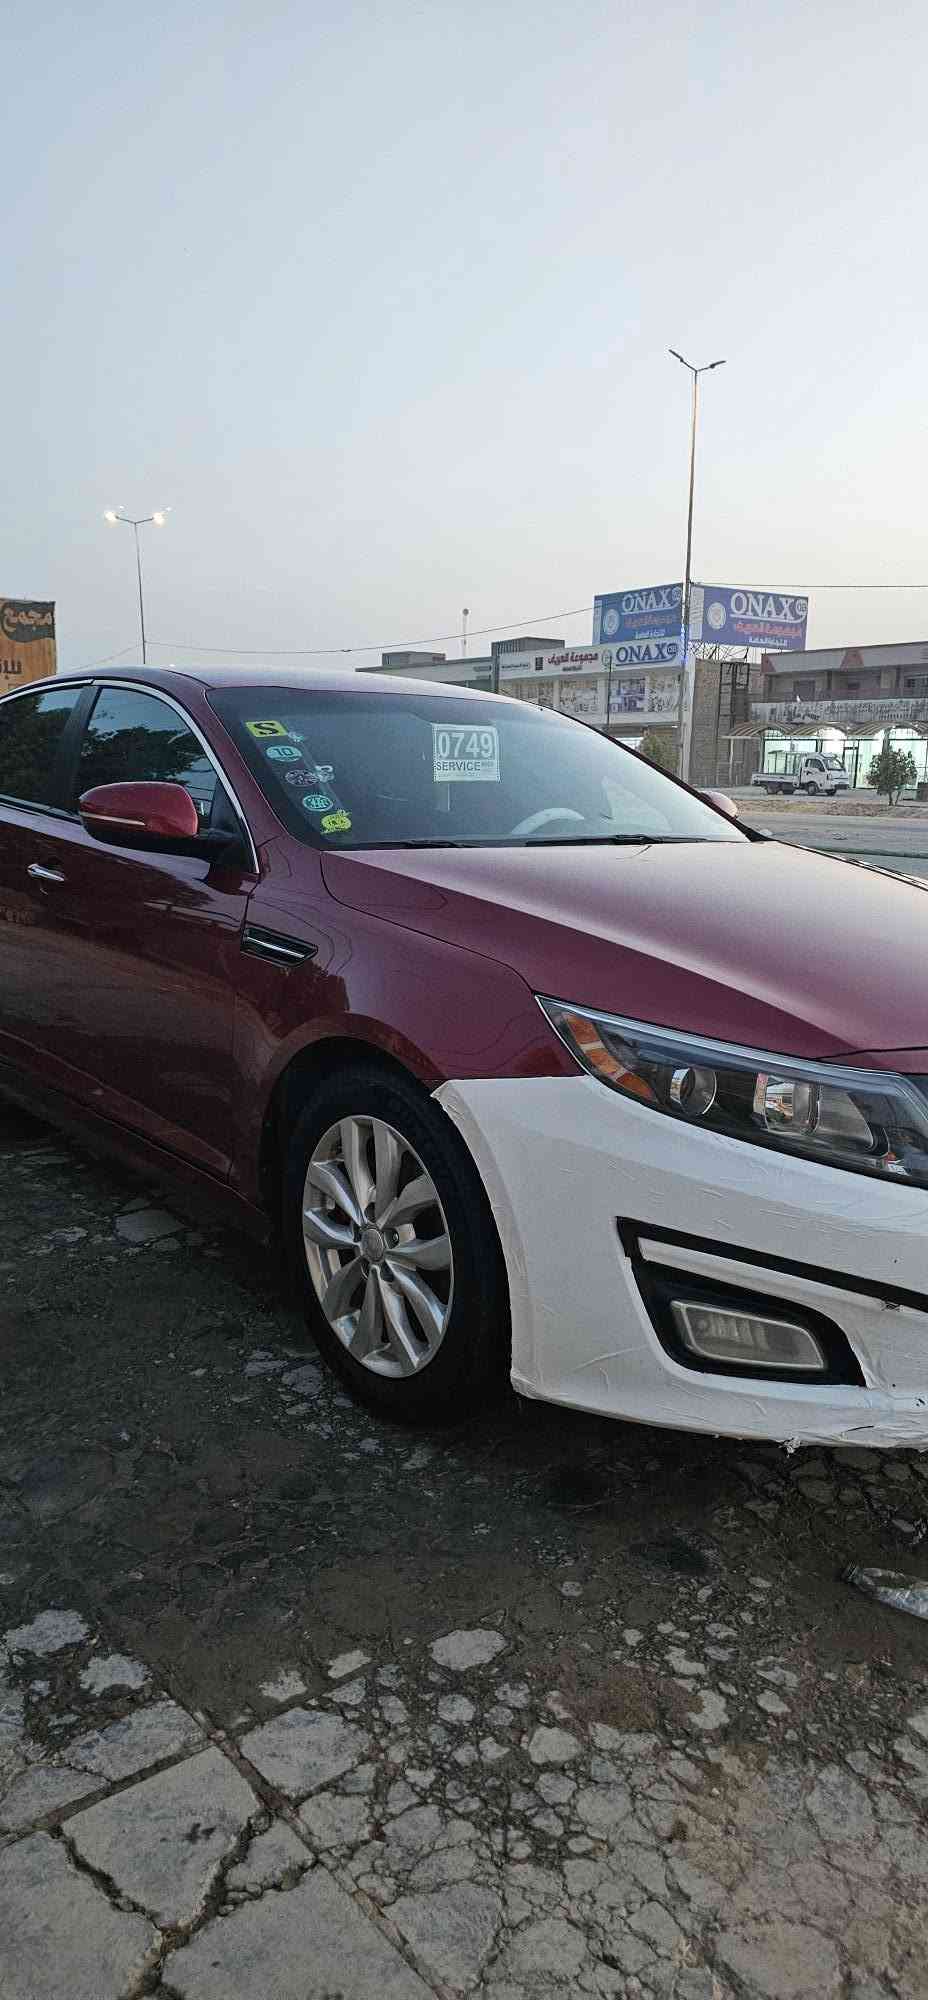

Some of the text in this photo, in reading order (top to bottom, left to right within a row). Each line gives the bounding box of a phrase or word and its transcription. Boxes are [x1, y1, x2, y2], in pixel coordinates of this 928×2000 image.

[622, 587, 671, 612] ONAX
[731, 591, 795, 620] ONAX
[616, 642, 667, 663] ONAX
[253, 721, 279, 736] S
[438, 731, 493, 758] 0749
[436, 760, 481, 771] SERVICE
